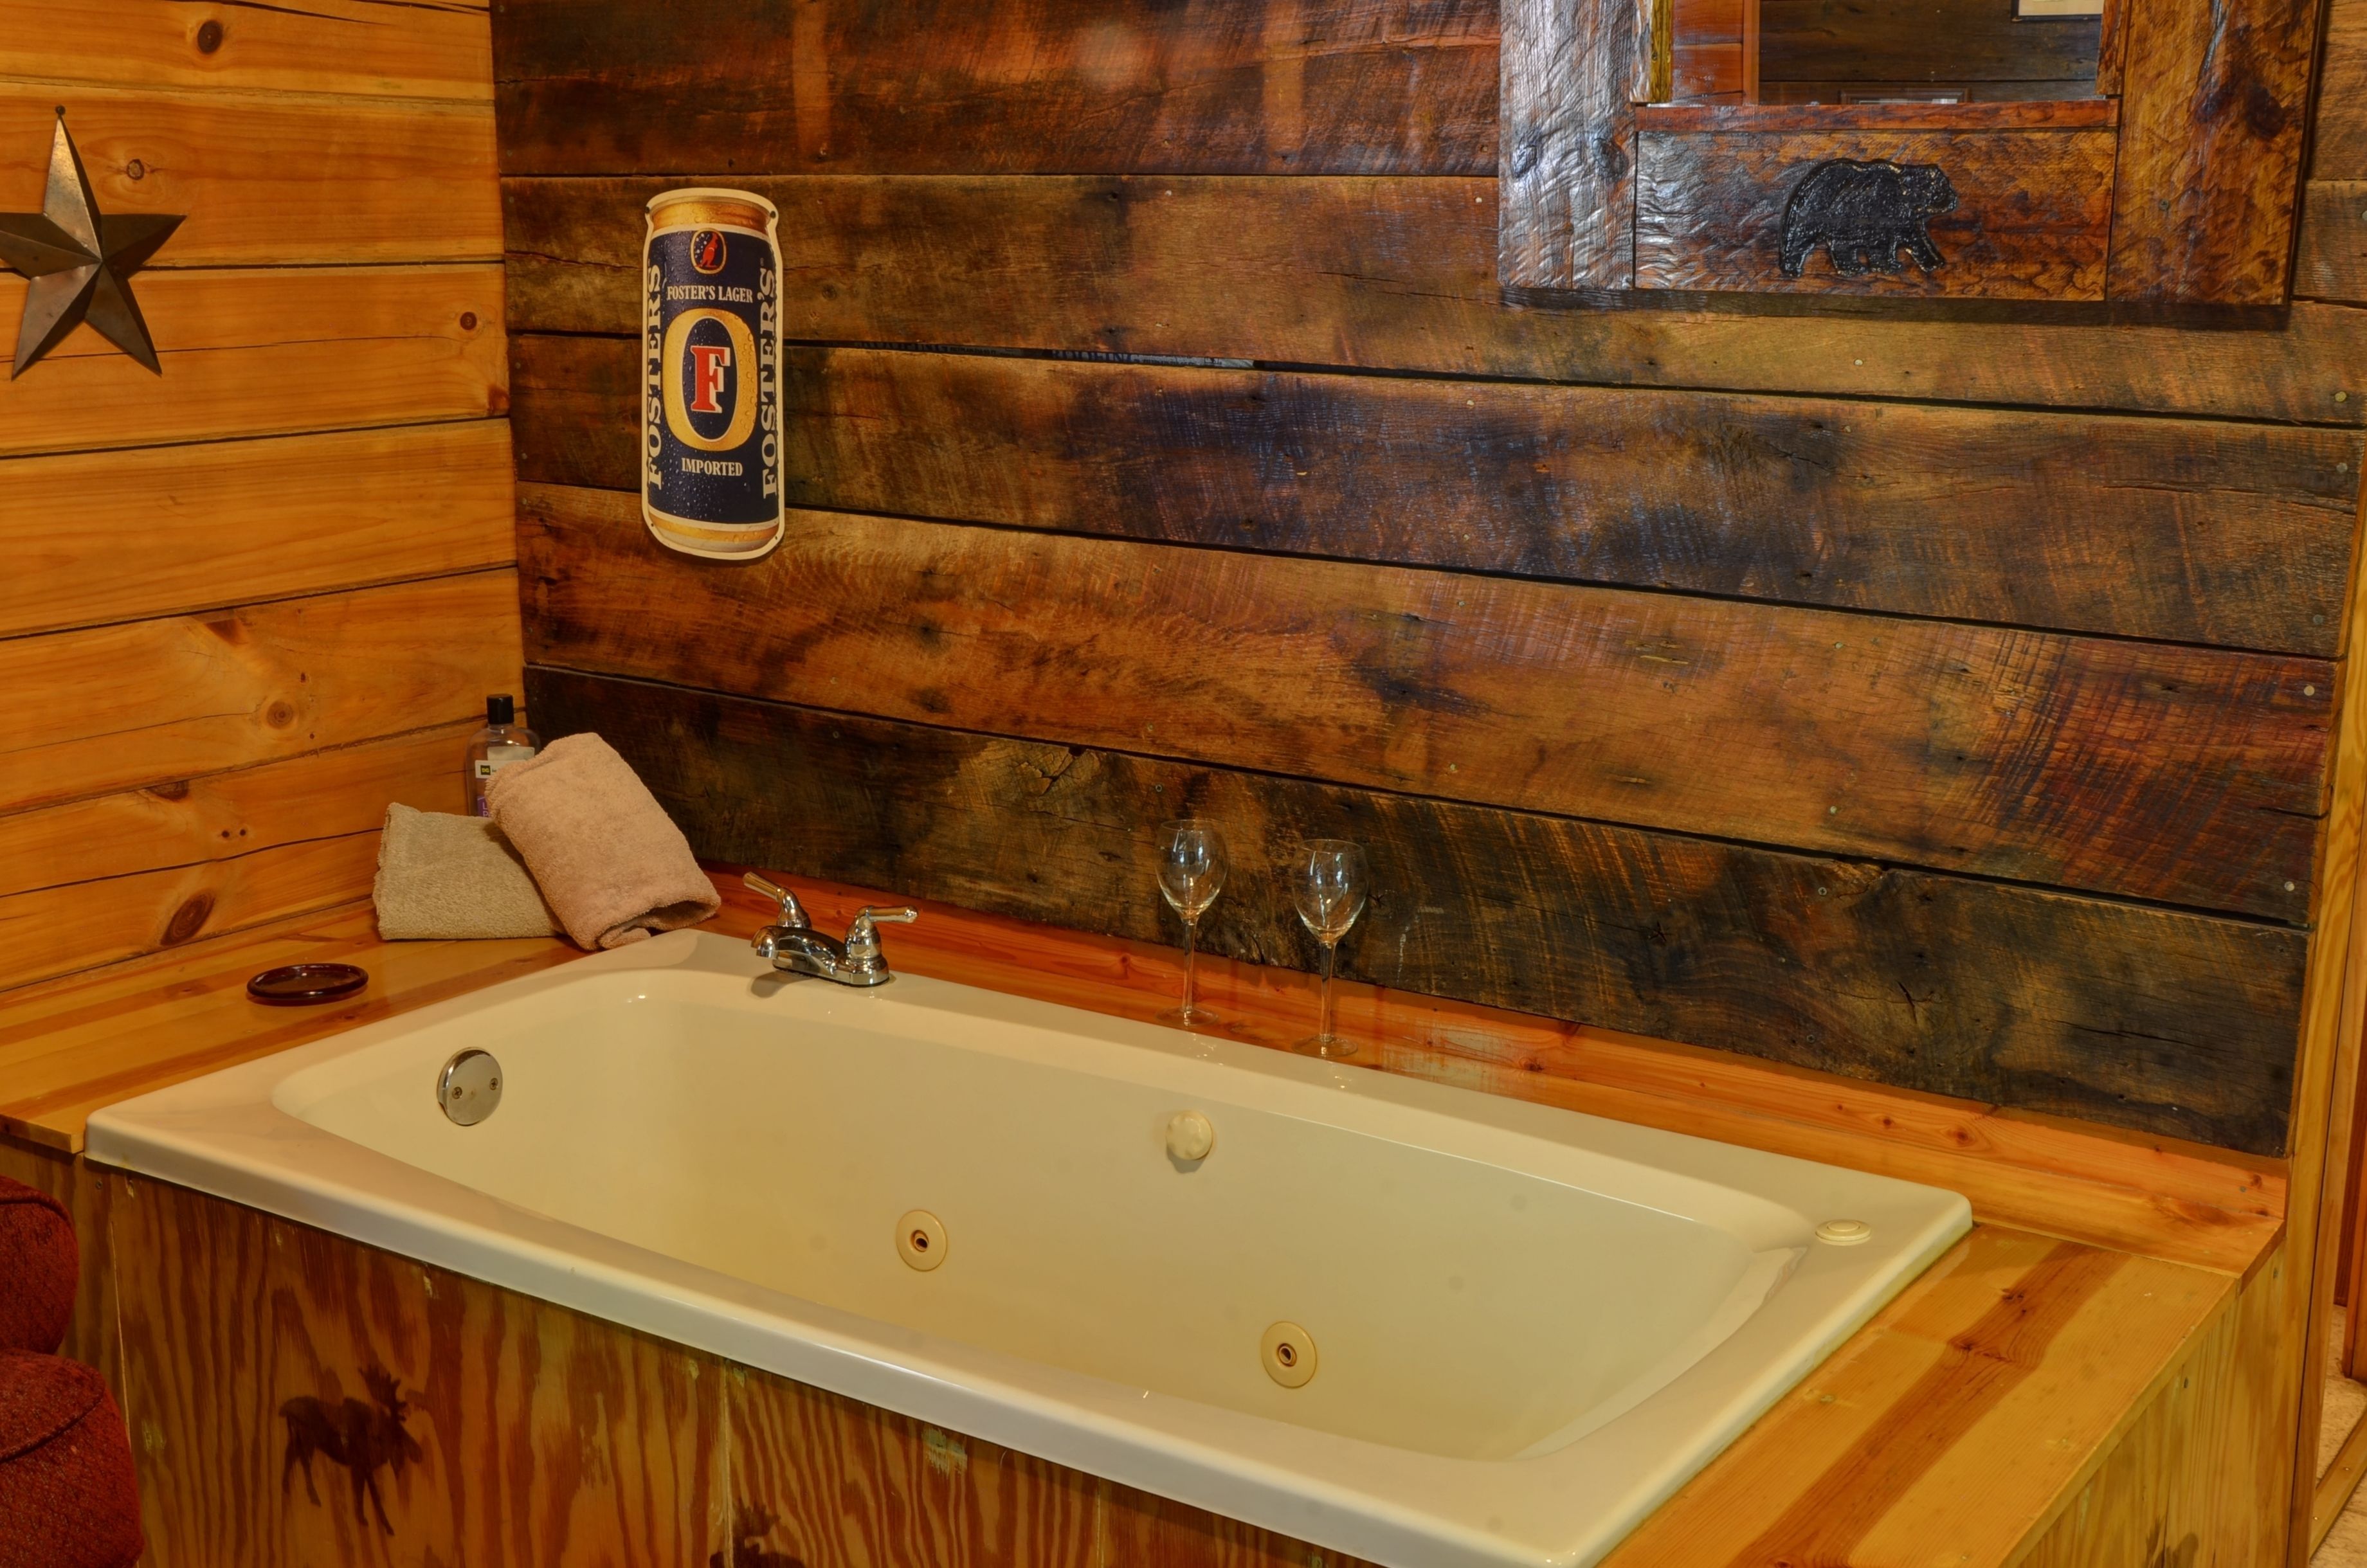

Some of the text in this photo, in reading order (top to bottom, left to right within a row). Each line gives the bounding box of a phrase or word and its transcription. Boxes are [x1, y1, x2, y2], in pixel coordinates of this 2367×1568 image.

[667, 285, 754, 303] FOSTER'S LAGER
[690, 345, 730, 413] F
[757, 267, 777, 499] FOSTER'S
[681, 457, 743, 476] IMPORTED
